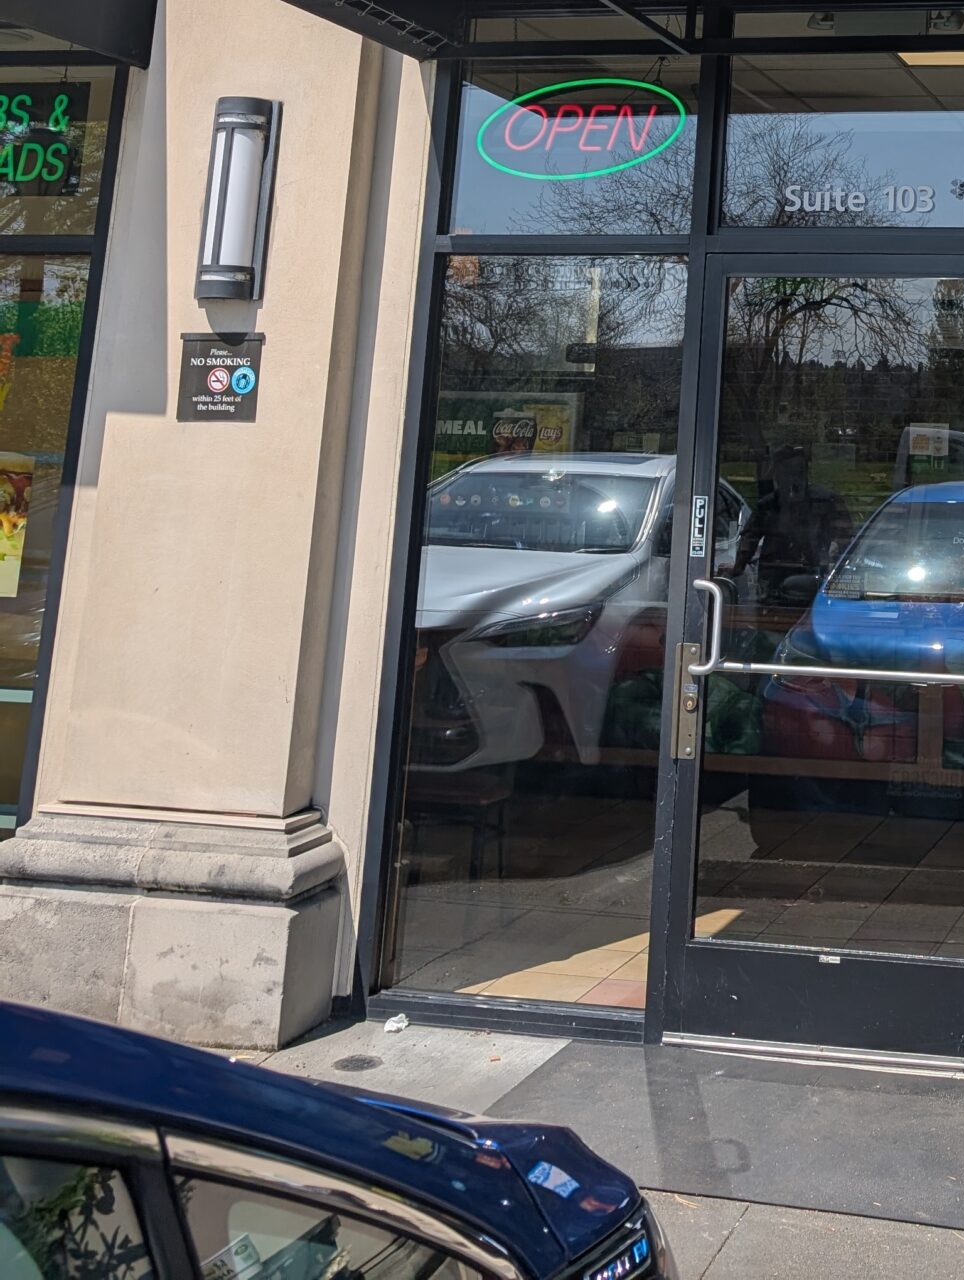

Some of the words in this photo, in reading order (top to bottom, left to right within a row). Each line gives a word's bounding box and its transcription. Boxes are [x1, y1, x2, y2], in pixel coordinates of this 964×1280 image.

[49, 94, 70, 132] &
[504, 104, 658, 152] OPEN
[784, 184, 866, 212] Suite
[885, 185, 937, 213] 103
[190, 357, 205, 366] NO
[206, 357, 251, 366] SMOKING
[192, 395, 213, 403] within
[213, 395, 222, 403] 25
[222, 395, 234, 403] feet
[234, 395, 242, 403] of
[197, 403, 208, 411] the
[208, 404, 236, 413] building
[436, 419, 487, 436] MEAL
[694, 499, 705, 538] PULL
